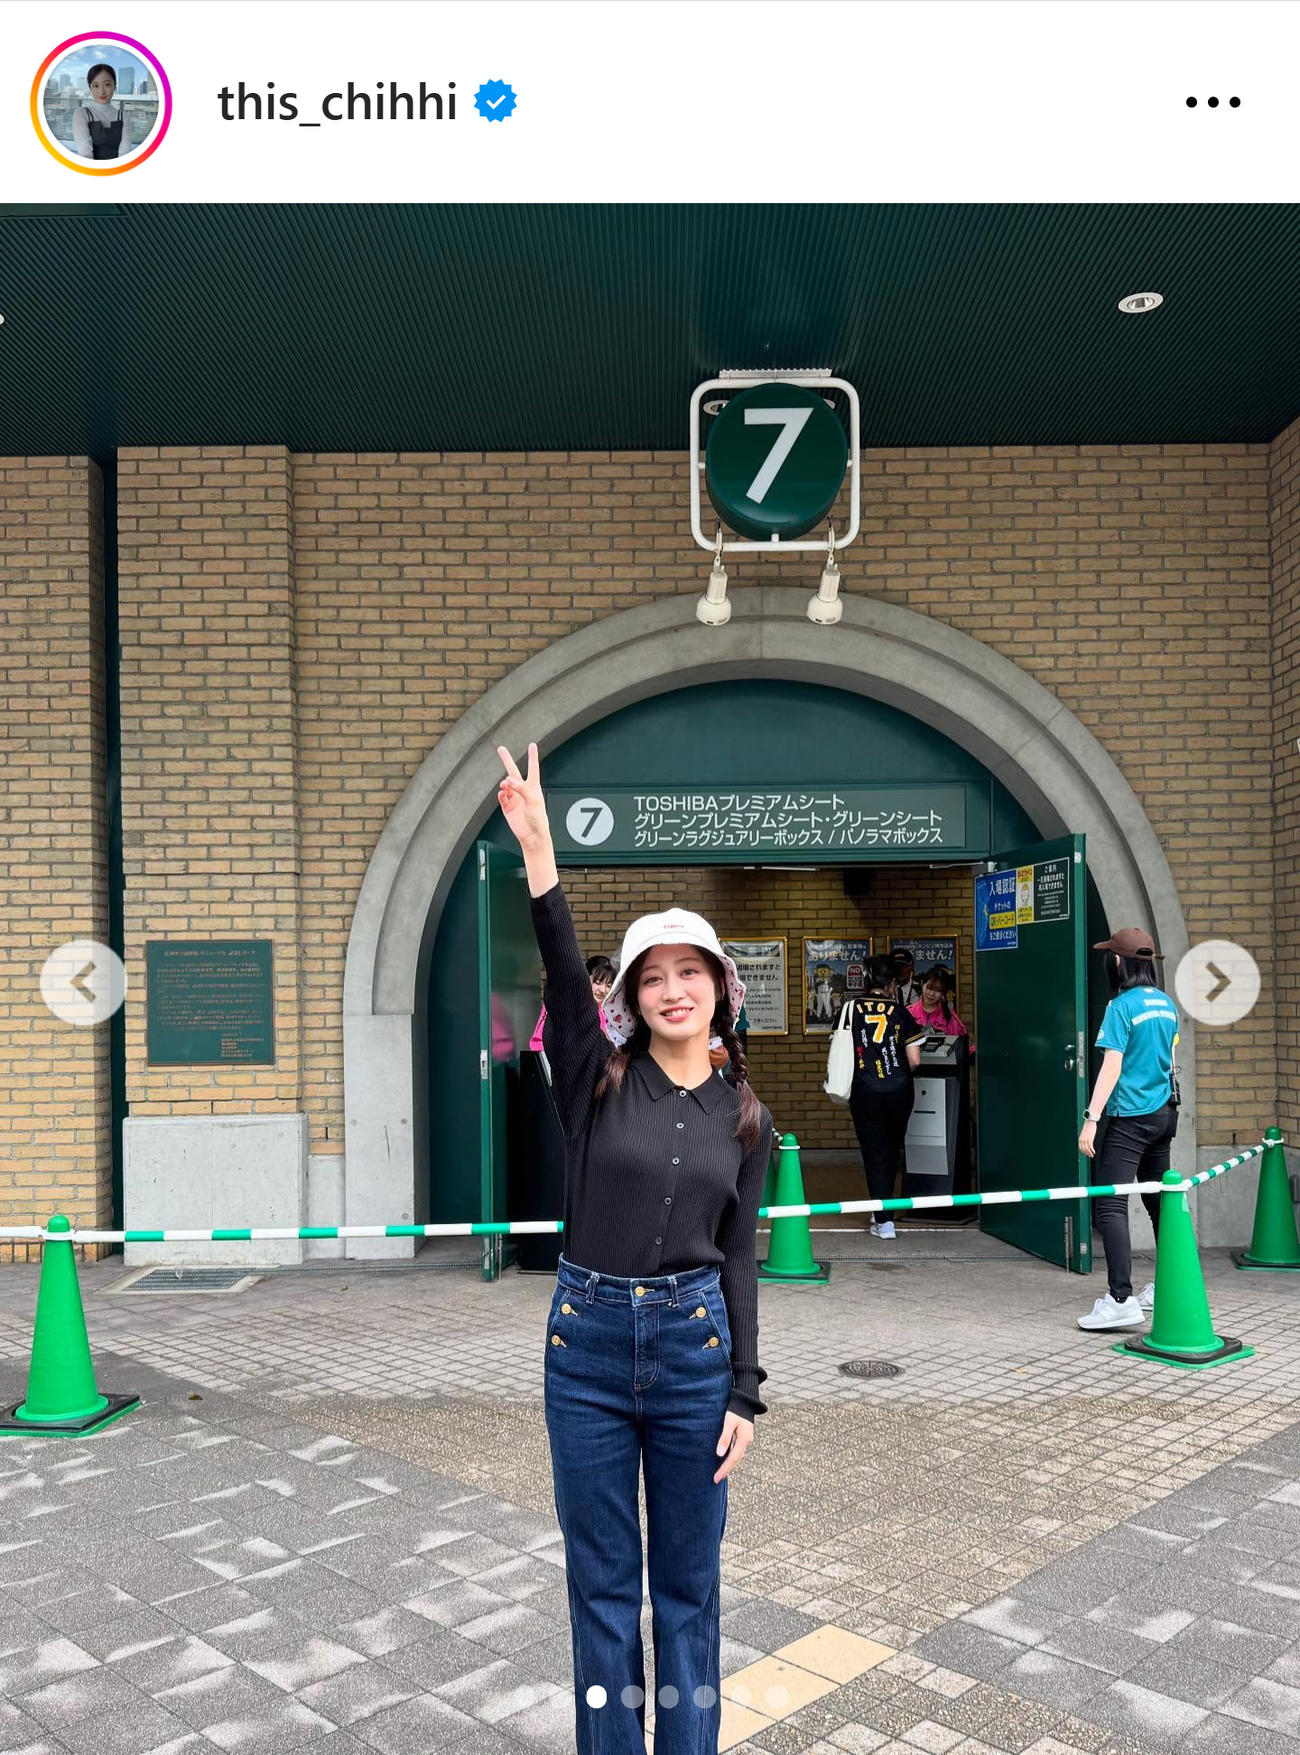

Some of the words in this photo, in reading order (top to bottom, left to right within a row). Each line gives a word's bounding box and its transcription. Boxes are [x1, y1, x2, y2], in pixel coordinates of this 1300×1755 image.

[744, 407, 814, 504] 7
[633, 793, 845, 811] TOSHIBAプレミアムシート
[579, 807, 603, 838] 7
[856, 1001, 895, 1016] ITOI
[864, 1013, 888, 1044] 7
